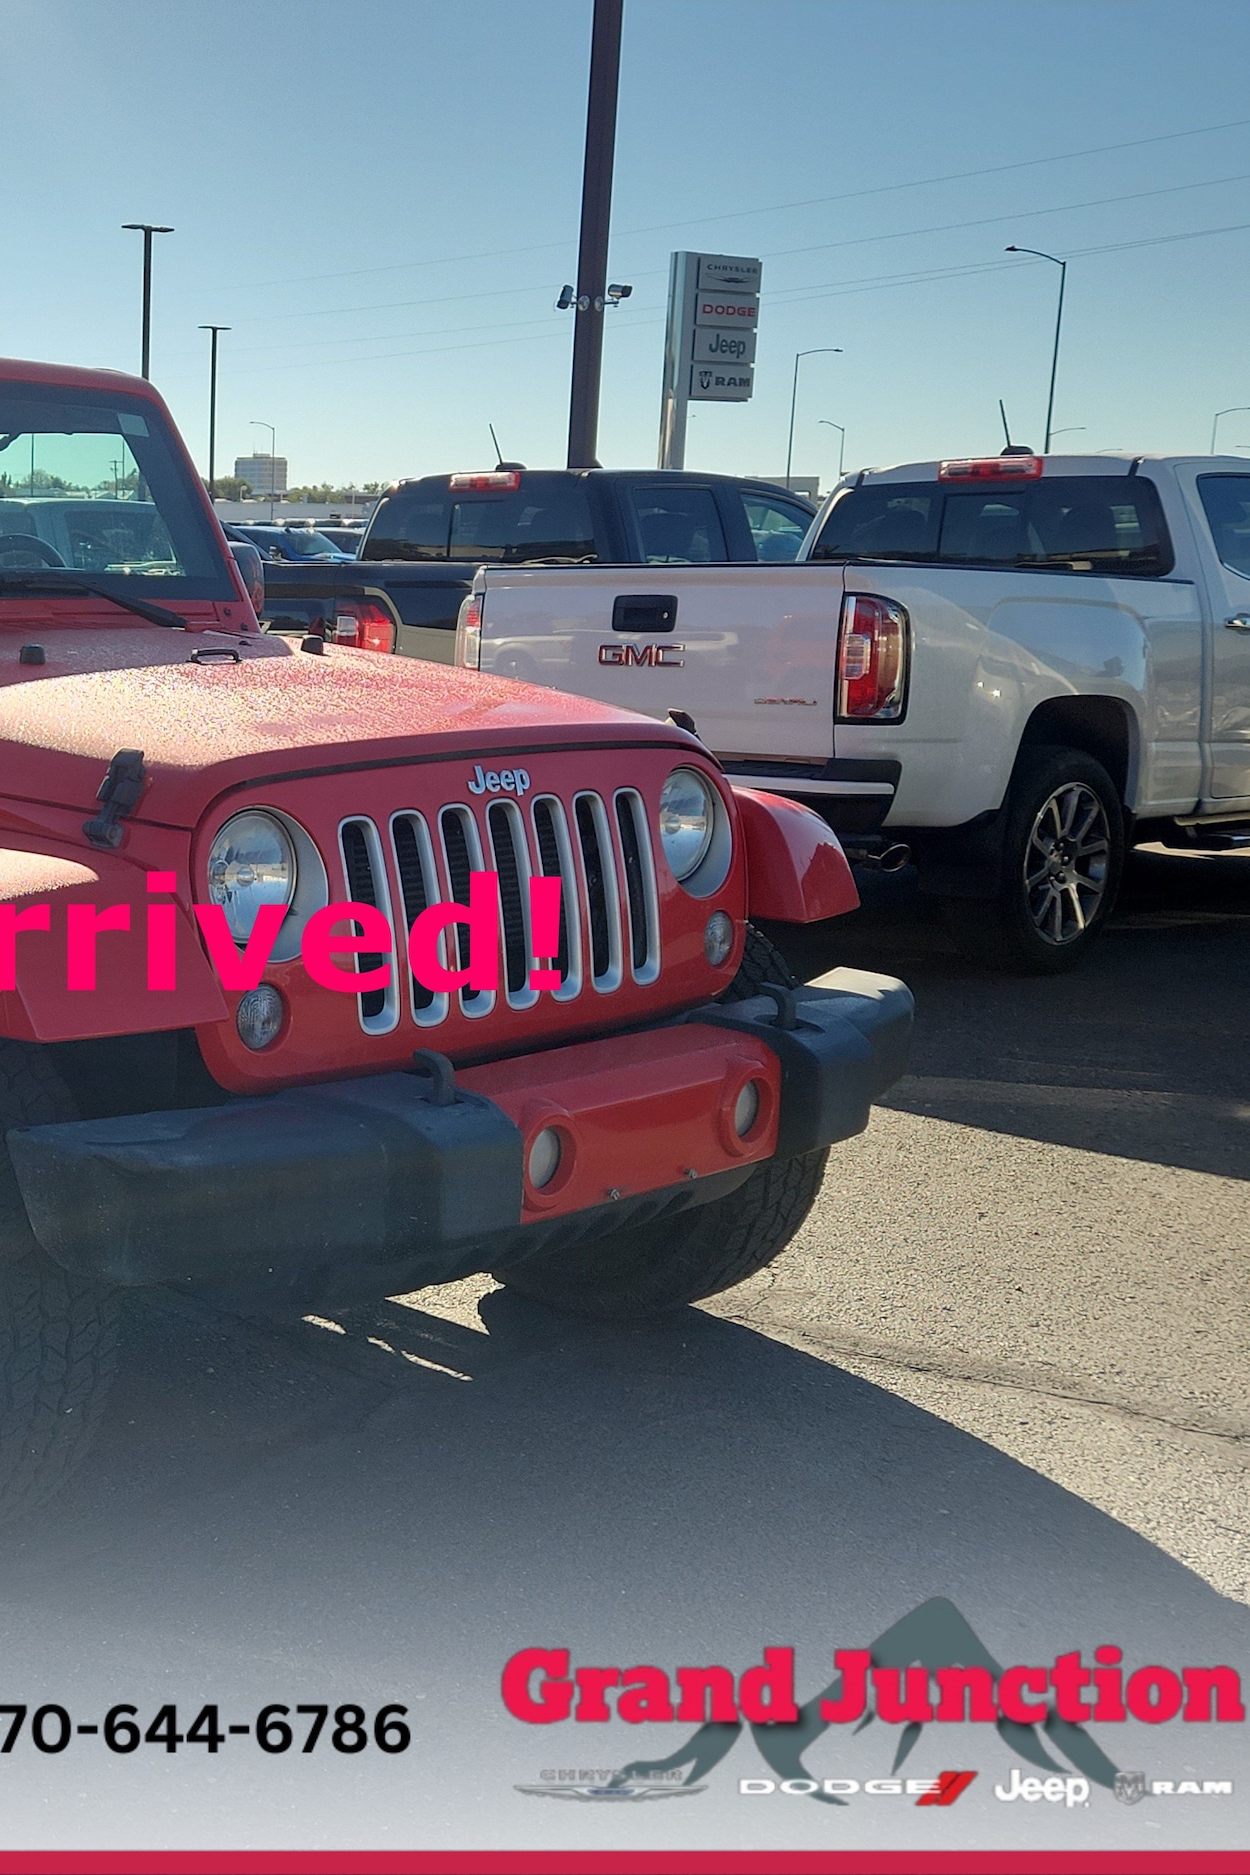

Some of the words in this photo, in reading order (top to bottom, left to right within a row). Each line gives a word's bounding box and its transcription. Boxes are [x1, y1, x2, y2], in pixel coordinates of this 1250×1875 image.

[707, 263, 758, 275] CHRYSLER
[702, 304, 756, 317] DODGE
[709, 333, 746, 358] Jeep
[714, 376, 751, 388] RAM
[598, 643, 685, 667] GMC
[467, 764, 530, 797] Jeep
